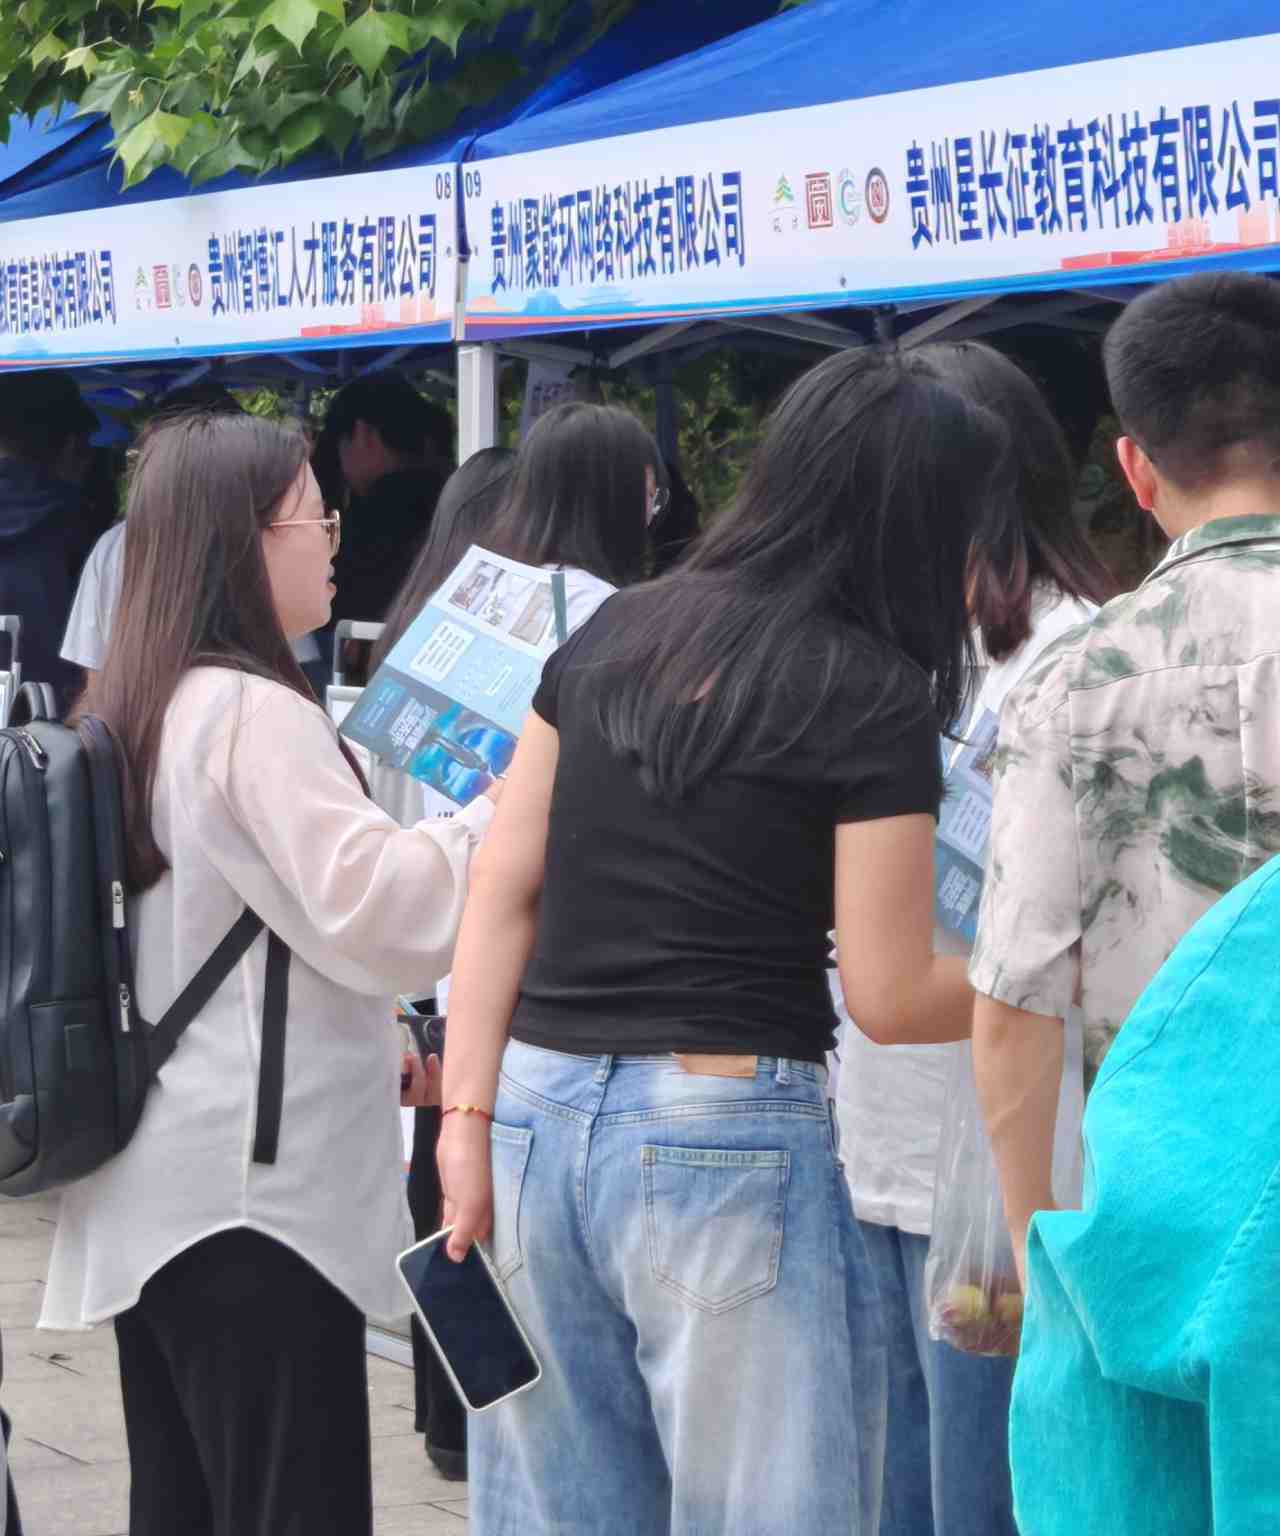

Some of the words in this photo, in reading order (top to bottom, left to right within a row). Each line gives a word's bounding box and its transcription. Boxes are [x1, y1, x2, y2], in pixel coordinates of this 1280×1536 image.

[435, 171, 452, 200] 08
[465, 169, 482, 199] 09
[208, 213, 437, 316] 贵州智博汇人才服务有限公司
[490, 170, 745, 294] 贵州聚能环网络科技有限公司
